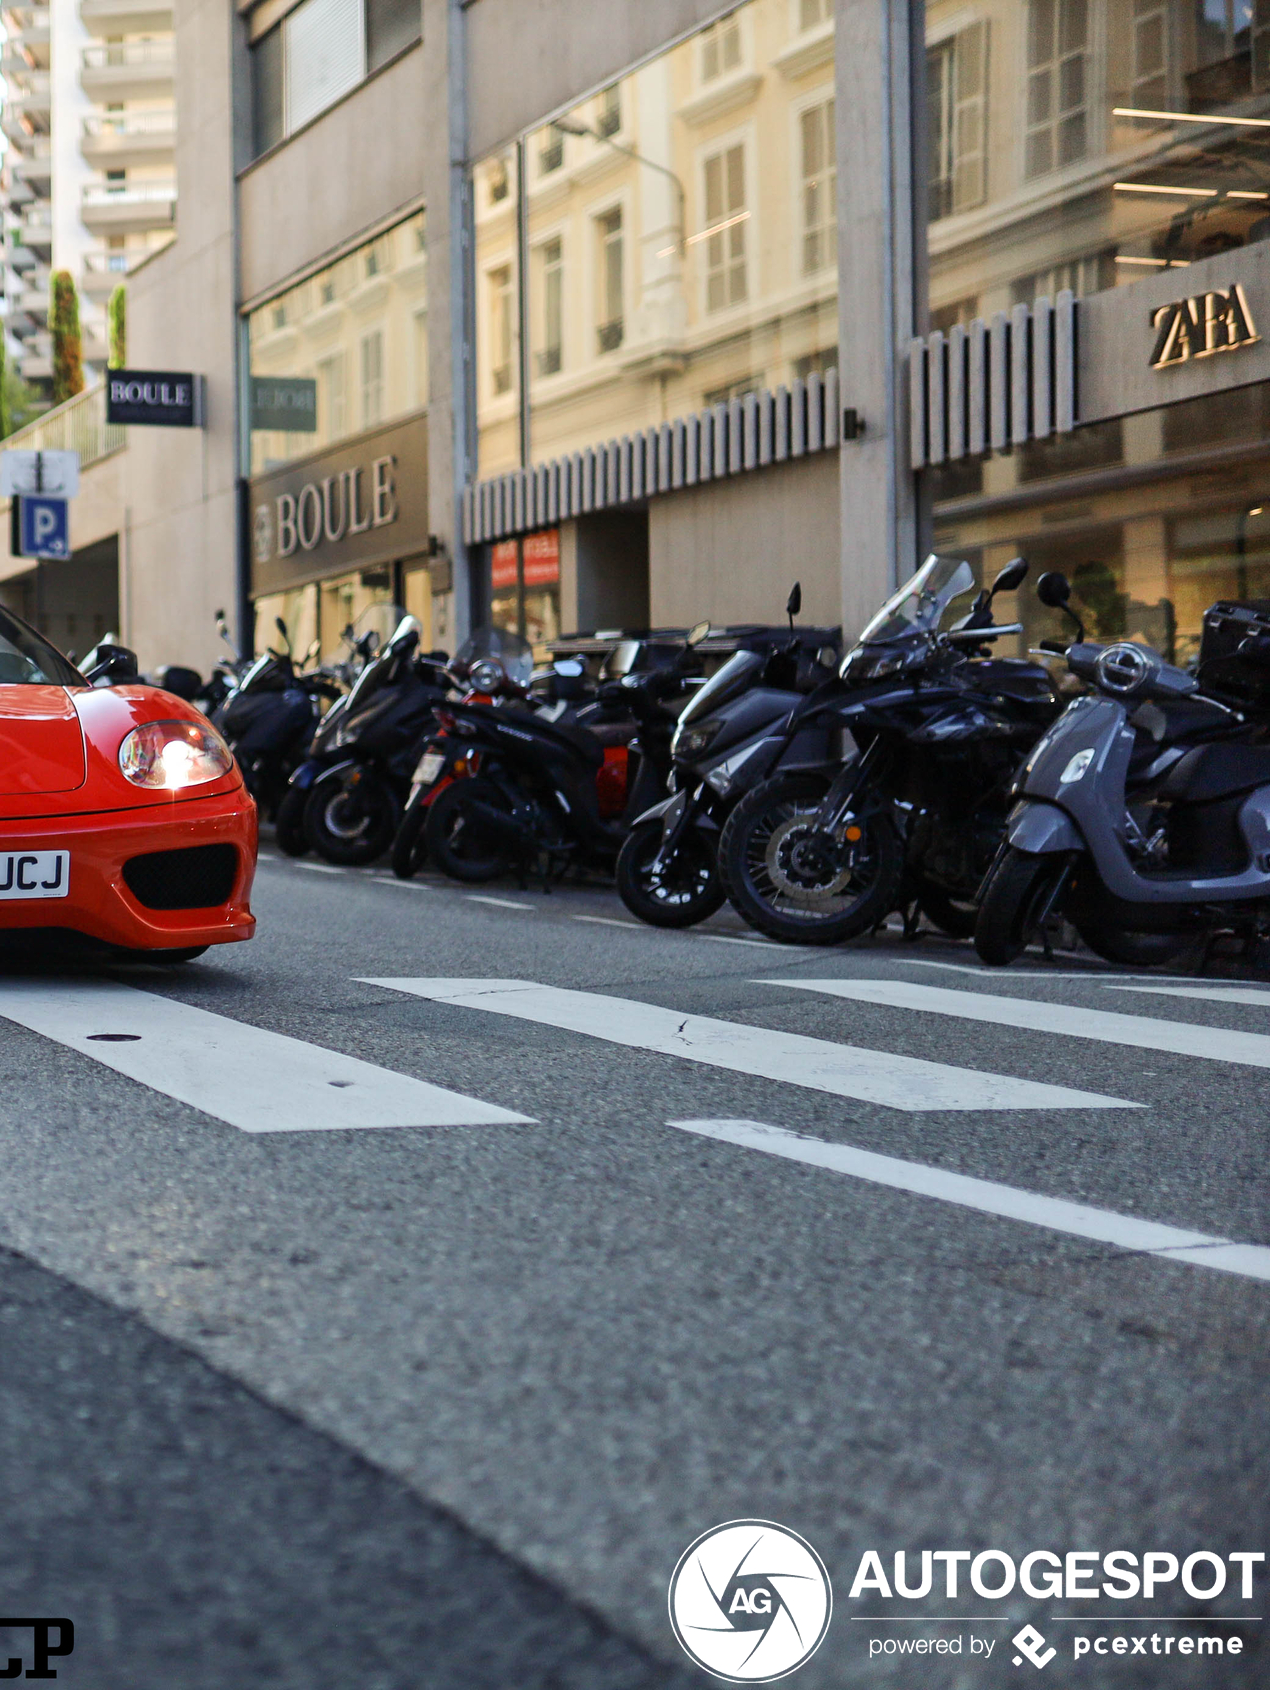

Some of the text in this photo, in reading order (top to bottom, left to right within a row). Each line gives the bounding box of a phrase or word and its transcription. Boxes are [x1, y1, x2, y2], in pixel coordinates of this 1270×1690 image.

[1149, 284, 1262, 370] ZARA
[111, 380, 191, 406] BOULE
[34, 506, 56, 545] P
[277, 455, 397, 558] BOULE
